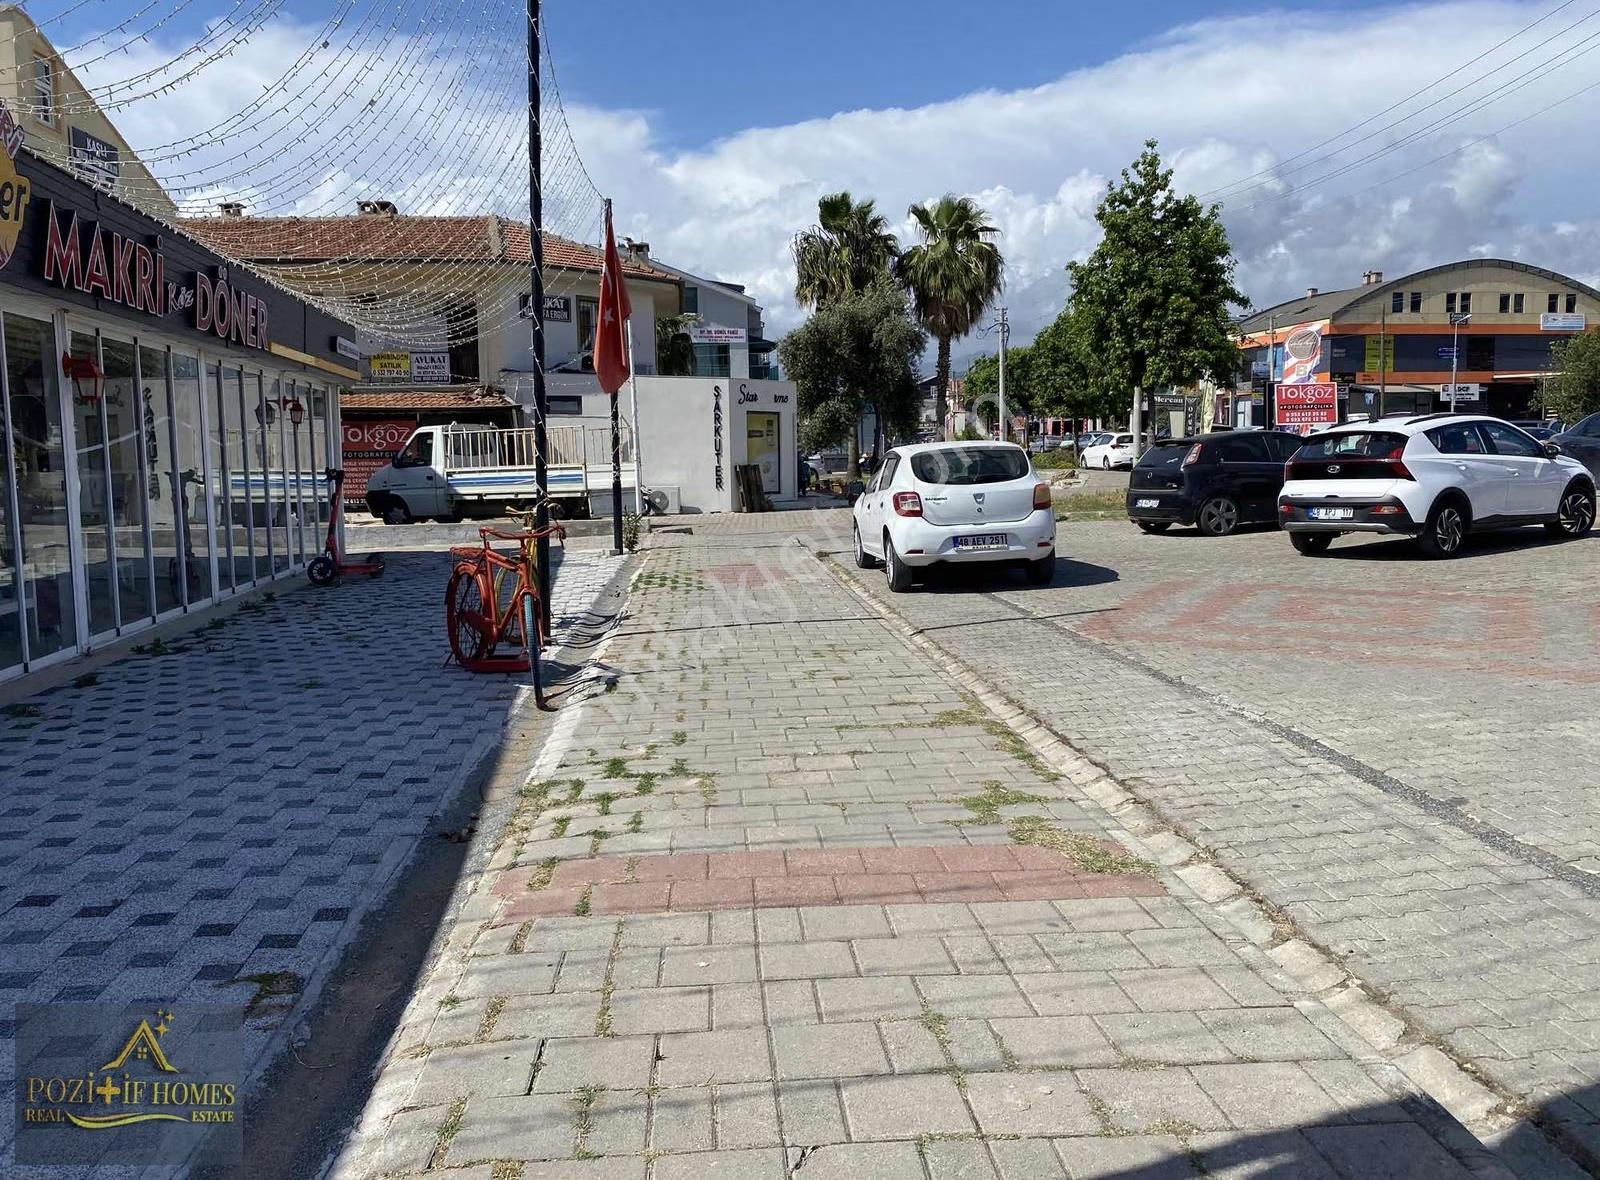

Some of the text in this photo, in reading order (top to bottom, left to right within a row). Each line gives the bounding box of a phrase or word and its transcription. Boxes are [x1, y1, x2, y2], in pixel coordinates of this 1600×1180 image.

[196, 264, 269, 351] DÖNER
[415, 355, 447, 364] AVUKAT
[971, 536, 986, 546] AEV
[989, 535, 1004, 545] 251
